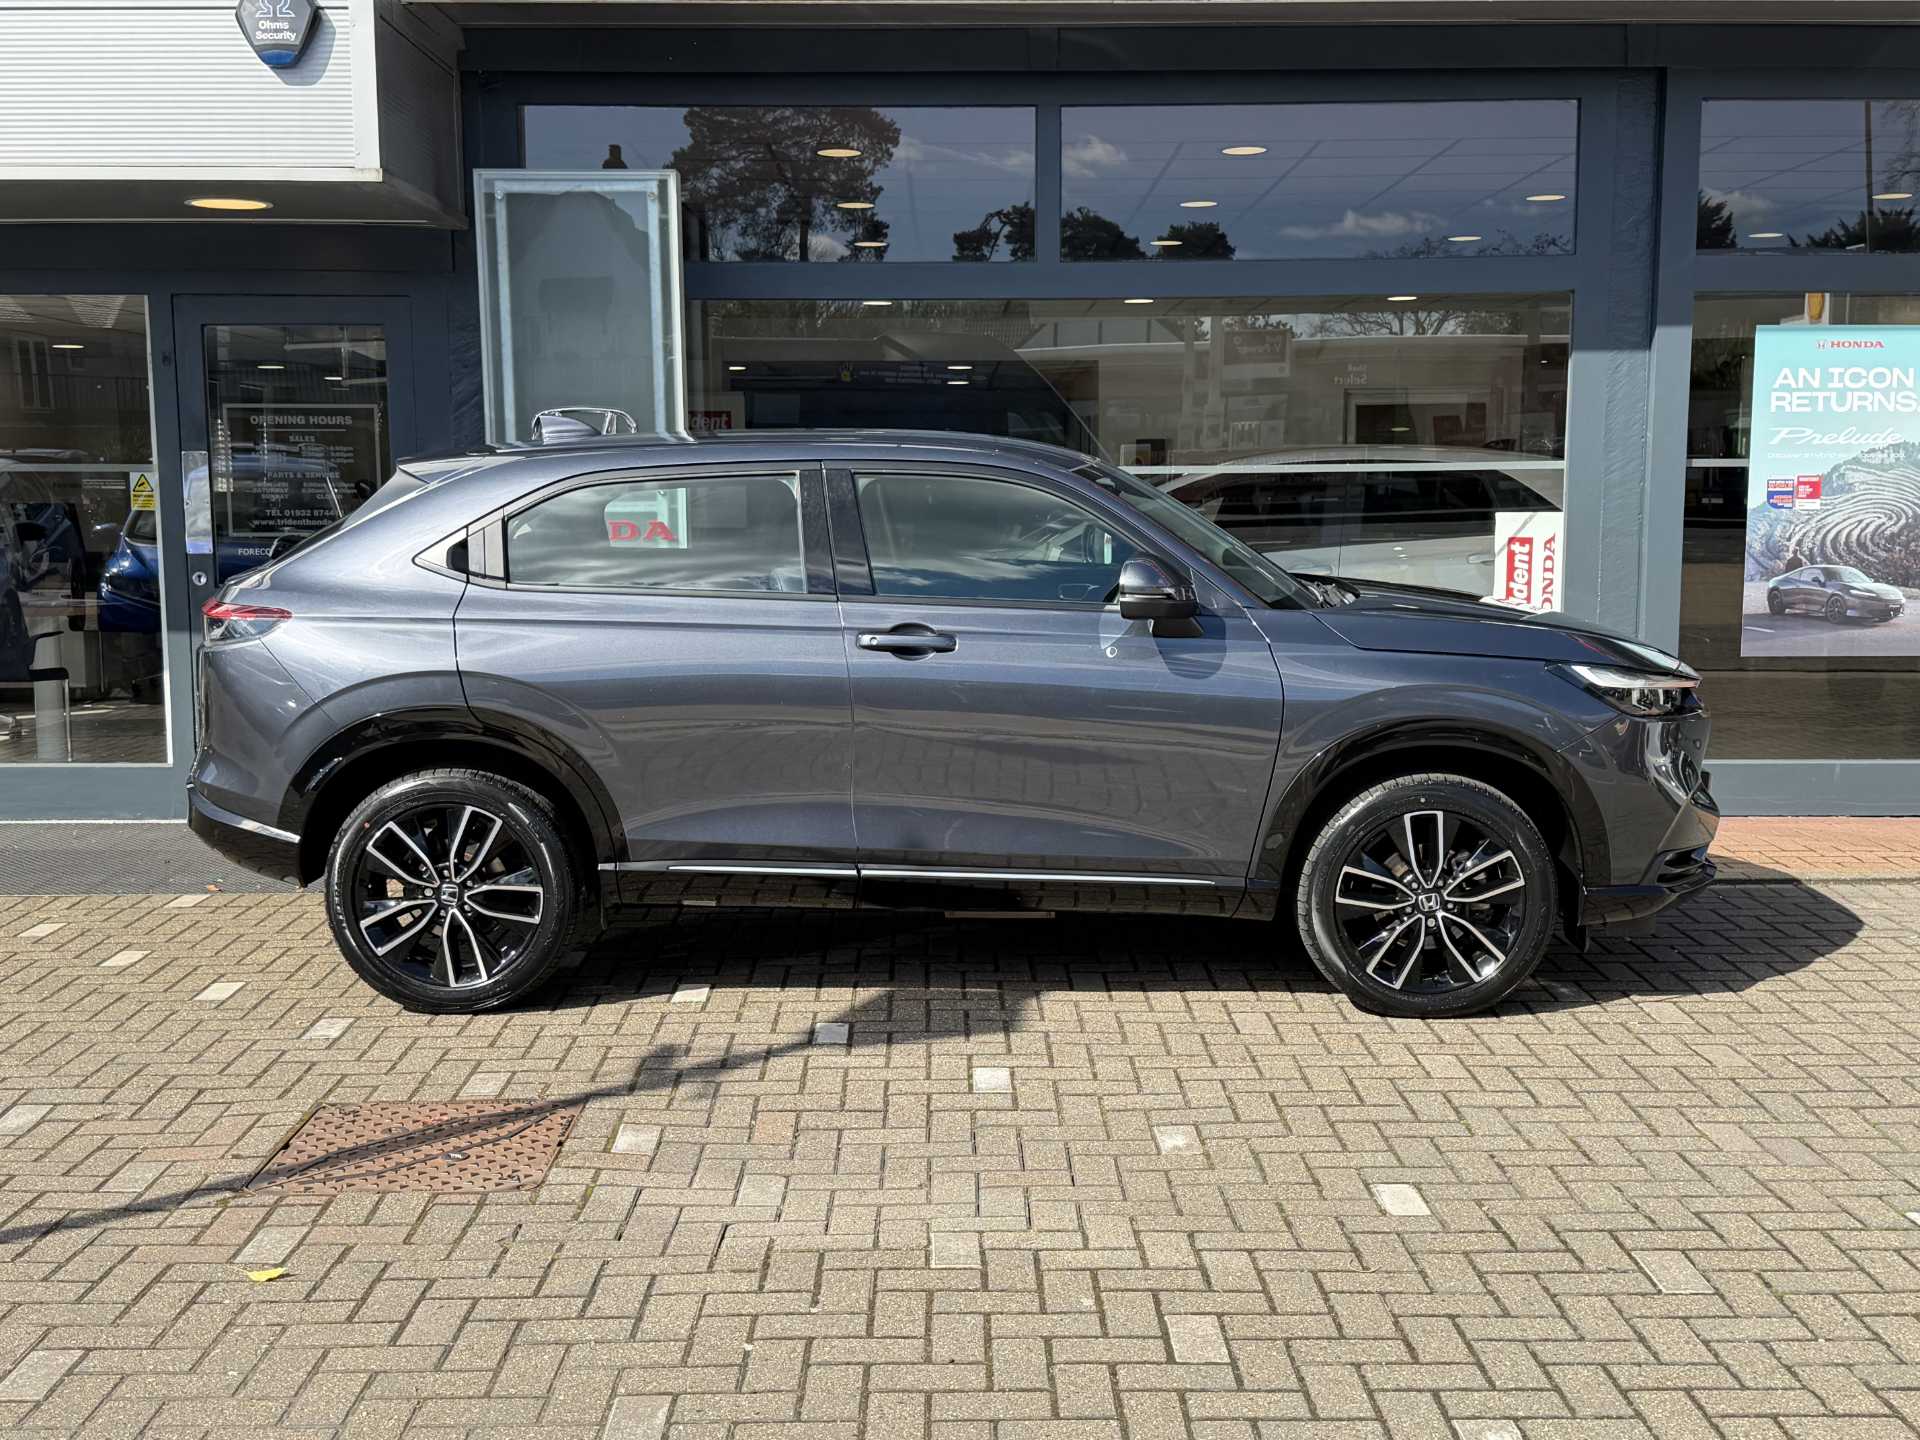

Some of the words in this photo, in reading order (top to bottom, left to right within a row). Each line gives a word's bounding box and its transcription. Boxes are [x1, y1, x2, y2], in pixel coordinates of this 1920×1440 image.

[258, 20, 289, 30] Ohms
[255, 31, 297, 41] Security
[1830, 340, 1885, 349] HONDA
[1773, 367, 1821, 389] AN
[1827, 366, 1915, 389] ICON
[250, 415, 306, 425] OPENING
[309, 415, 353, 425] HOURS
[1767, 426, 1906, 446] Prelude
[265, 509, 282, 517] TEL
